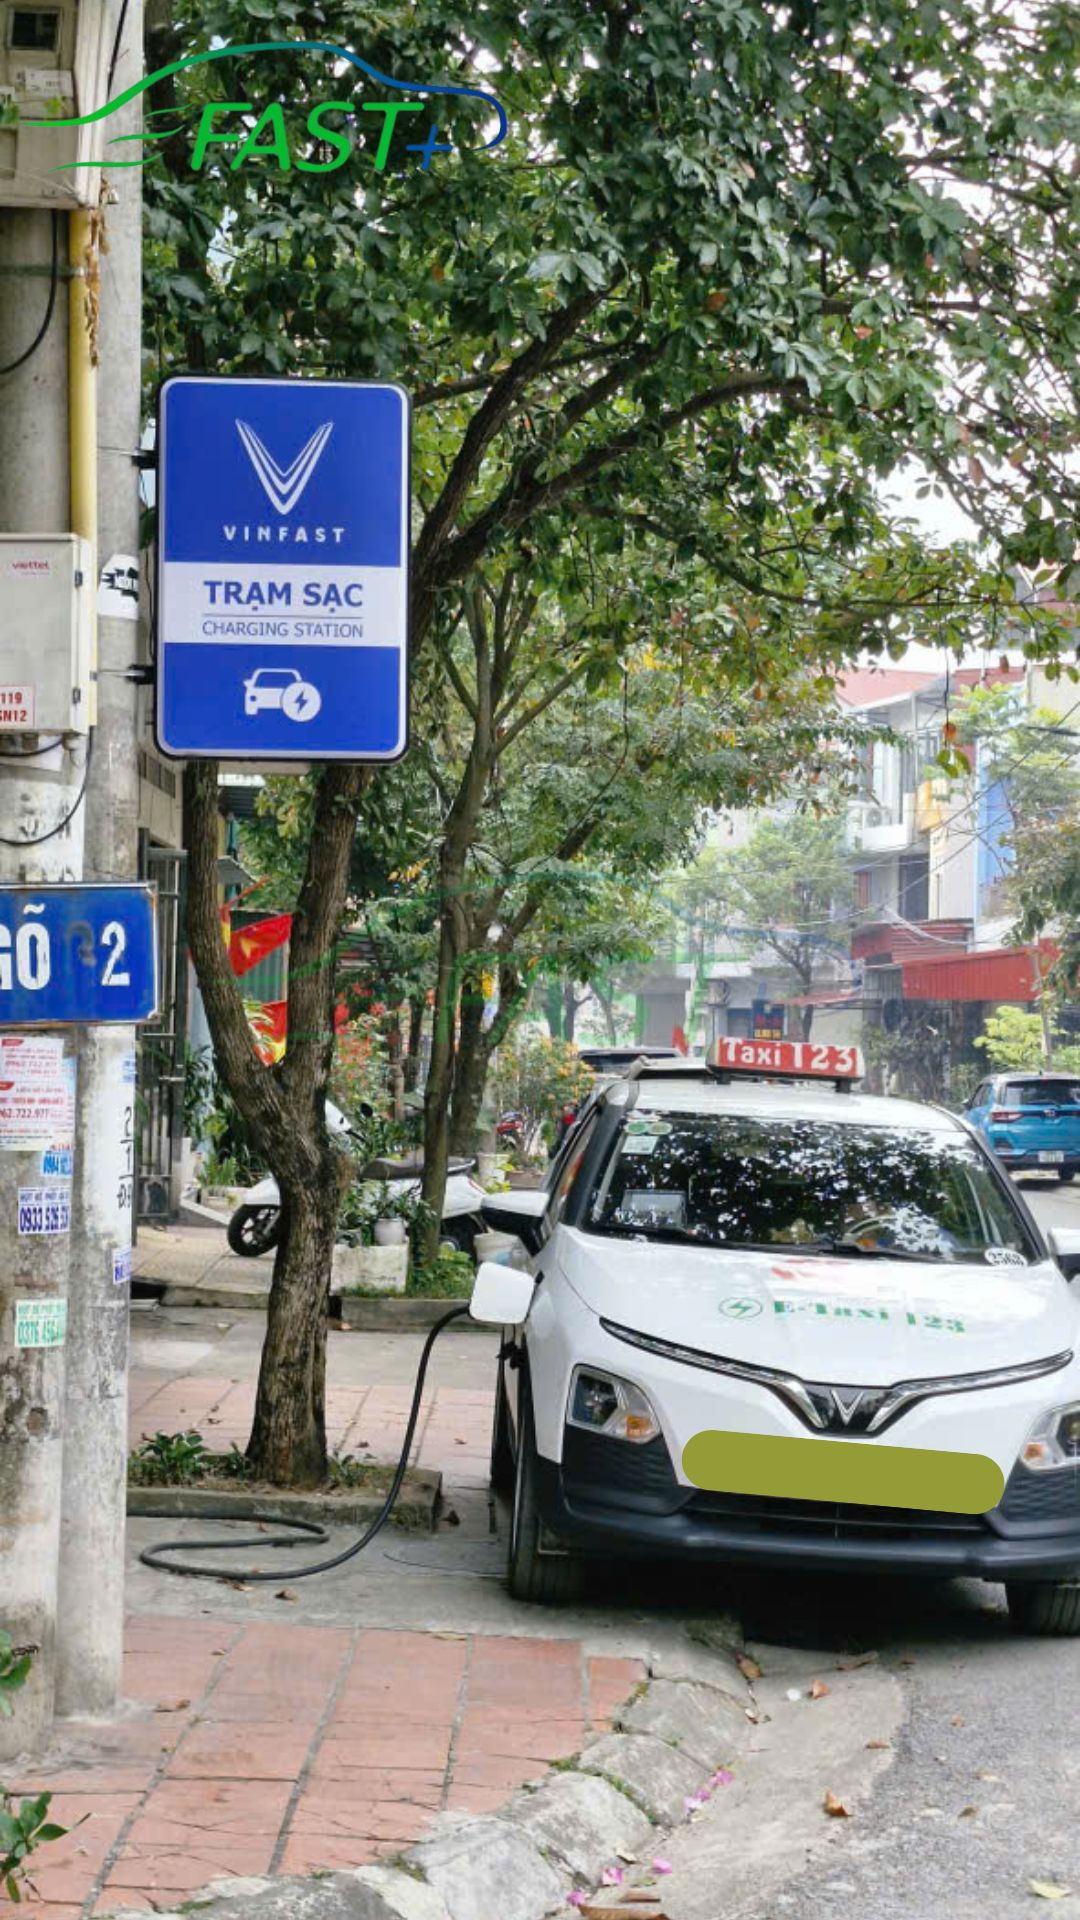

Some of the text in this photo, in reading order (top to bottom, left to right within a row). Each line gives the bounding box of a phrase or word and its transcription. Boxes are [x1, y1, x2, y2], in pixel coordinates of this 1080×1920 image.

[223, 525, 346, 544] VINFAST
[203, 581, 364, 613] TRẠM SẠC
[201, 620, 364, 639] CHARGING STATION
[101, 920, 131, 987] 2
[723, 1036, 854, 1073] Taxi 123
[906, 1311, 966, 1333] 123
